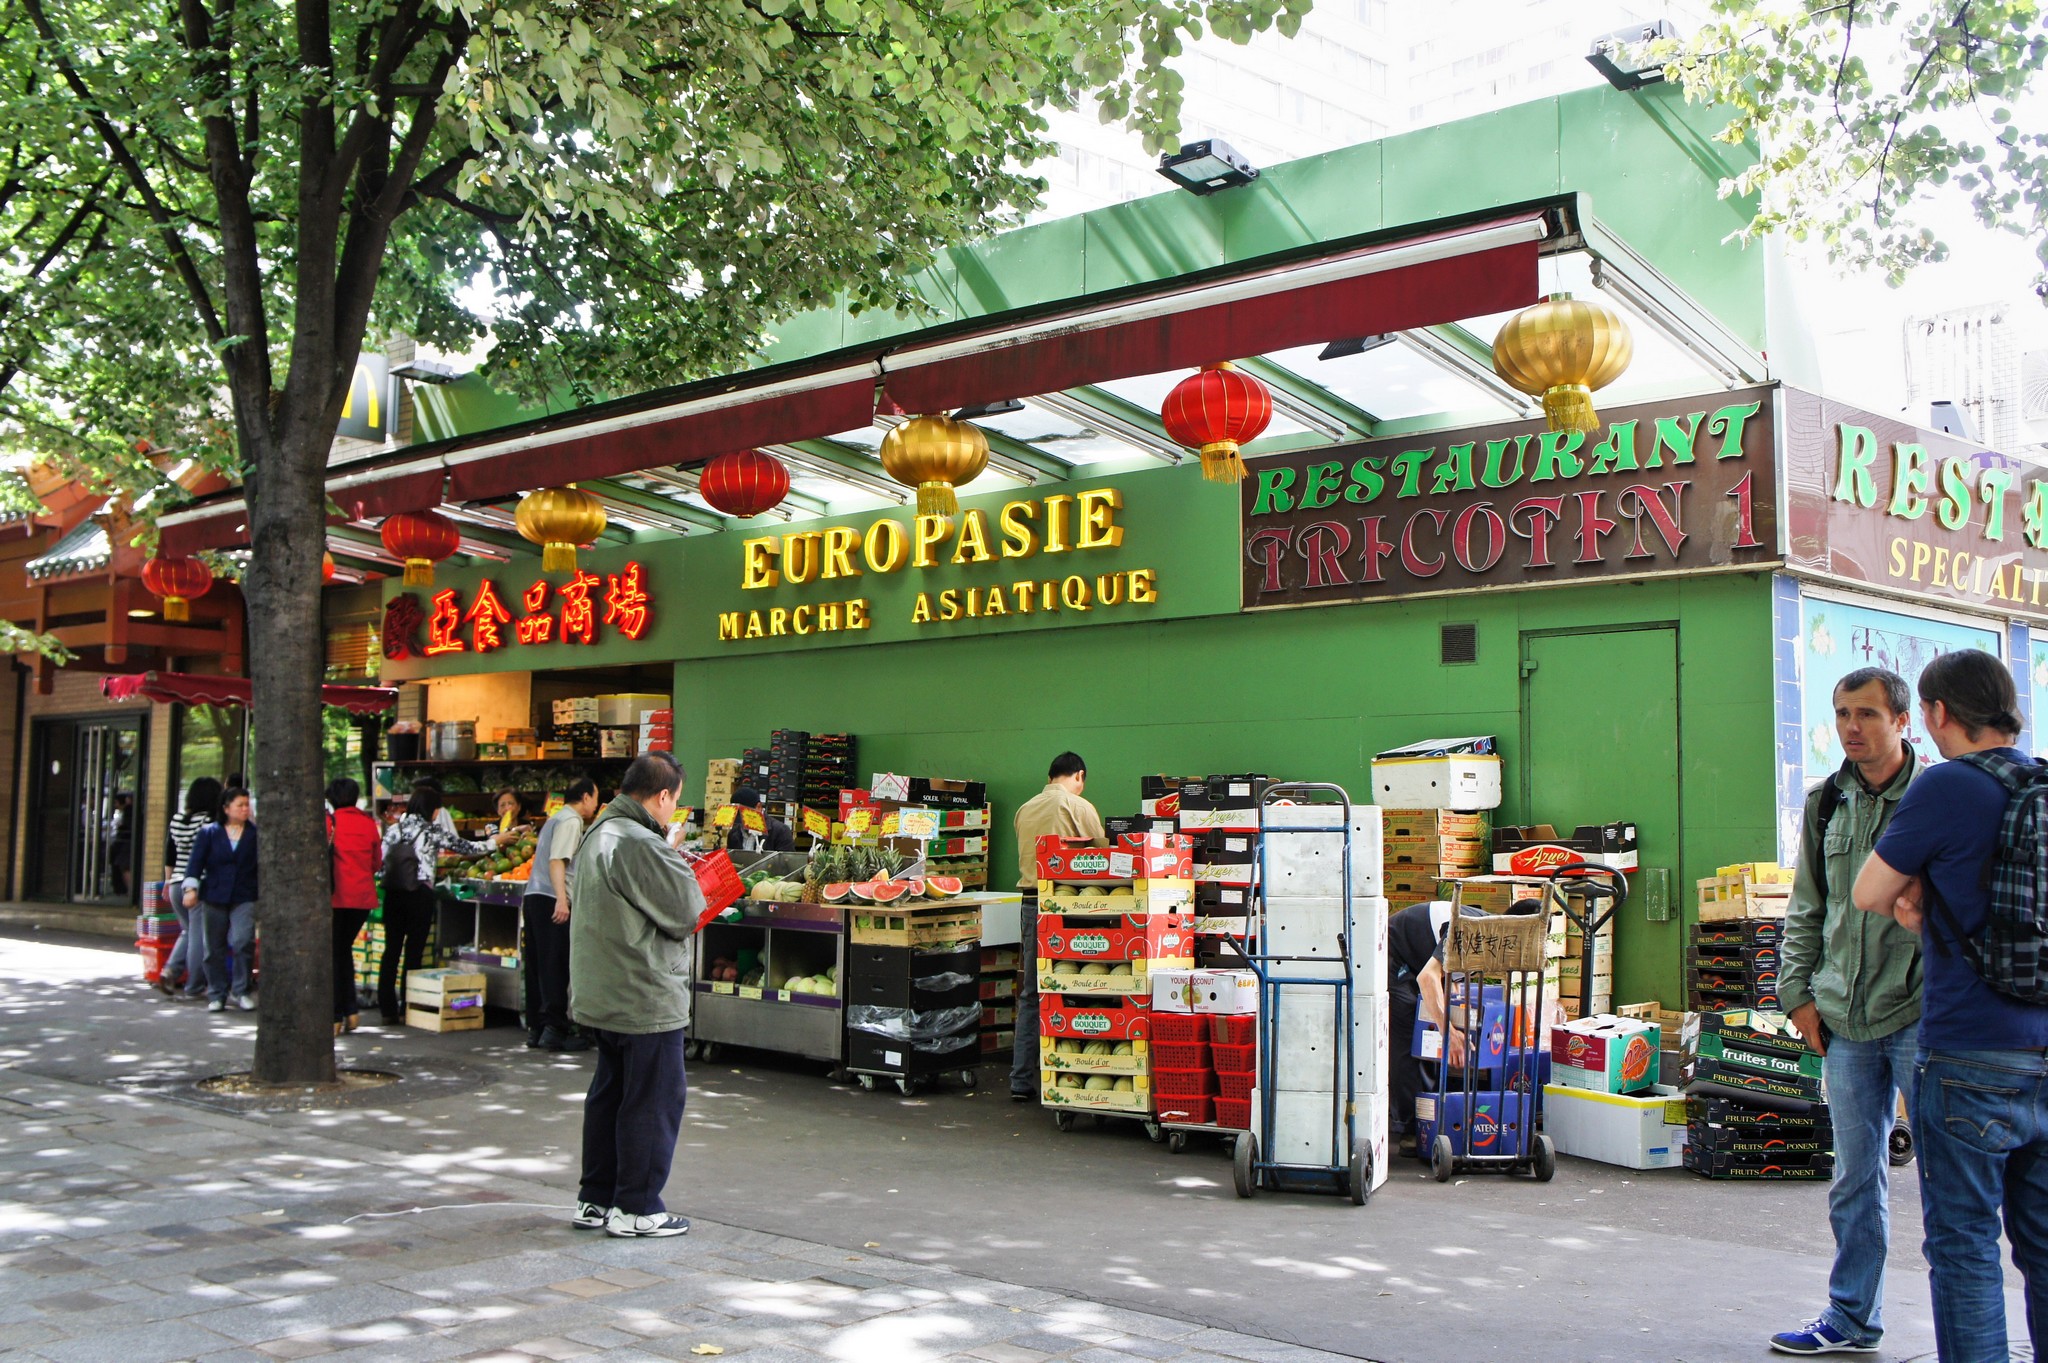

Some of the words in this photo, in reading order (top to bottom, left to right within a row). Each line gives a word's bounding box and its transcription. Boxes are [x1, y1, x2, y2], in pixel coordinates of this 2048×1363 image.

[1250, 400, 1761, 516] RESTAURANT
[741, 487, 1124, 589] EUROPASIE
[1247, 480, 1692, 592] TRICOTIN
[1725, 470, 1765, 549] 1
[1888, 537, 2048, 607] SPECIALI
[718, 598, 871, 640] MARCHE
[911, 569, 1157, 624] ASIATIQUE
[923, 794, 939, 802] SOLEIL
[1073, 860, 1106, 869] BOUQUET
[1522, 847, 1571, 867] Azuer
[1073, 941, 1106, 949] BOUQUET
[1170, 977, 1188, 985] YOUNG
[1074, 1020, 1107, 1029] BOUQUET
[1719, 1029, 1749, 1039] FRUITS
[1772, 1038, 1806, 1050] PONENT
[1722, 1048, 1767, 1066] fruites
[1771, 1058, 1799, 1072] font
[1713, 1073, 1744, 1085] FRUITS
[1768, 1084, 1803, 1095] PONENT
